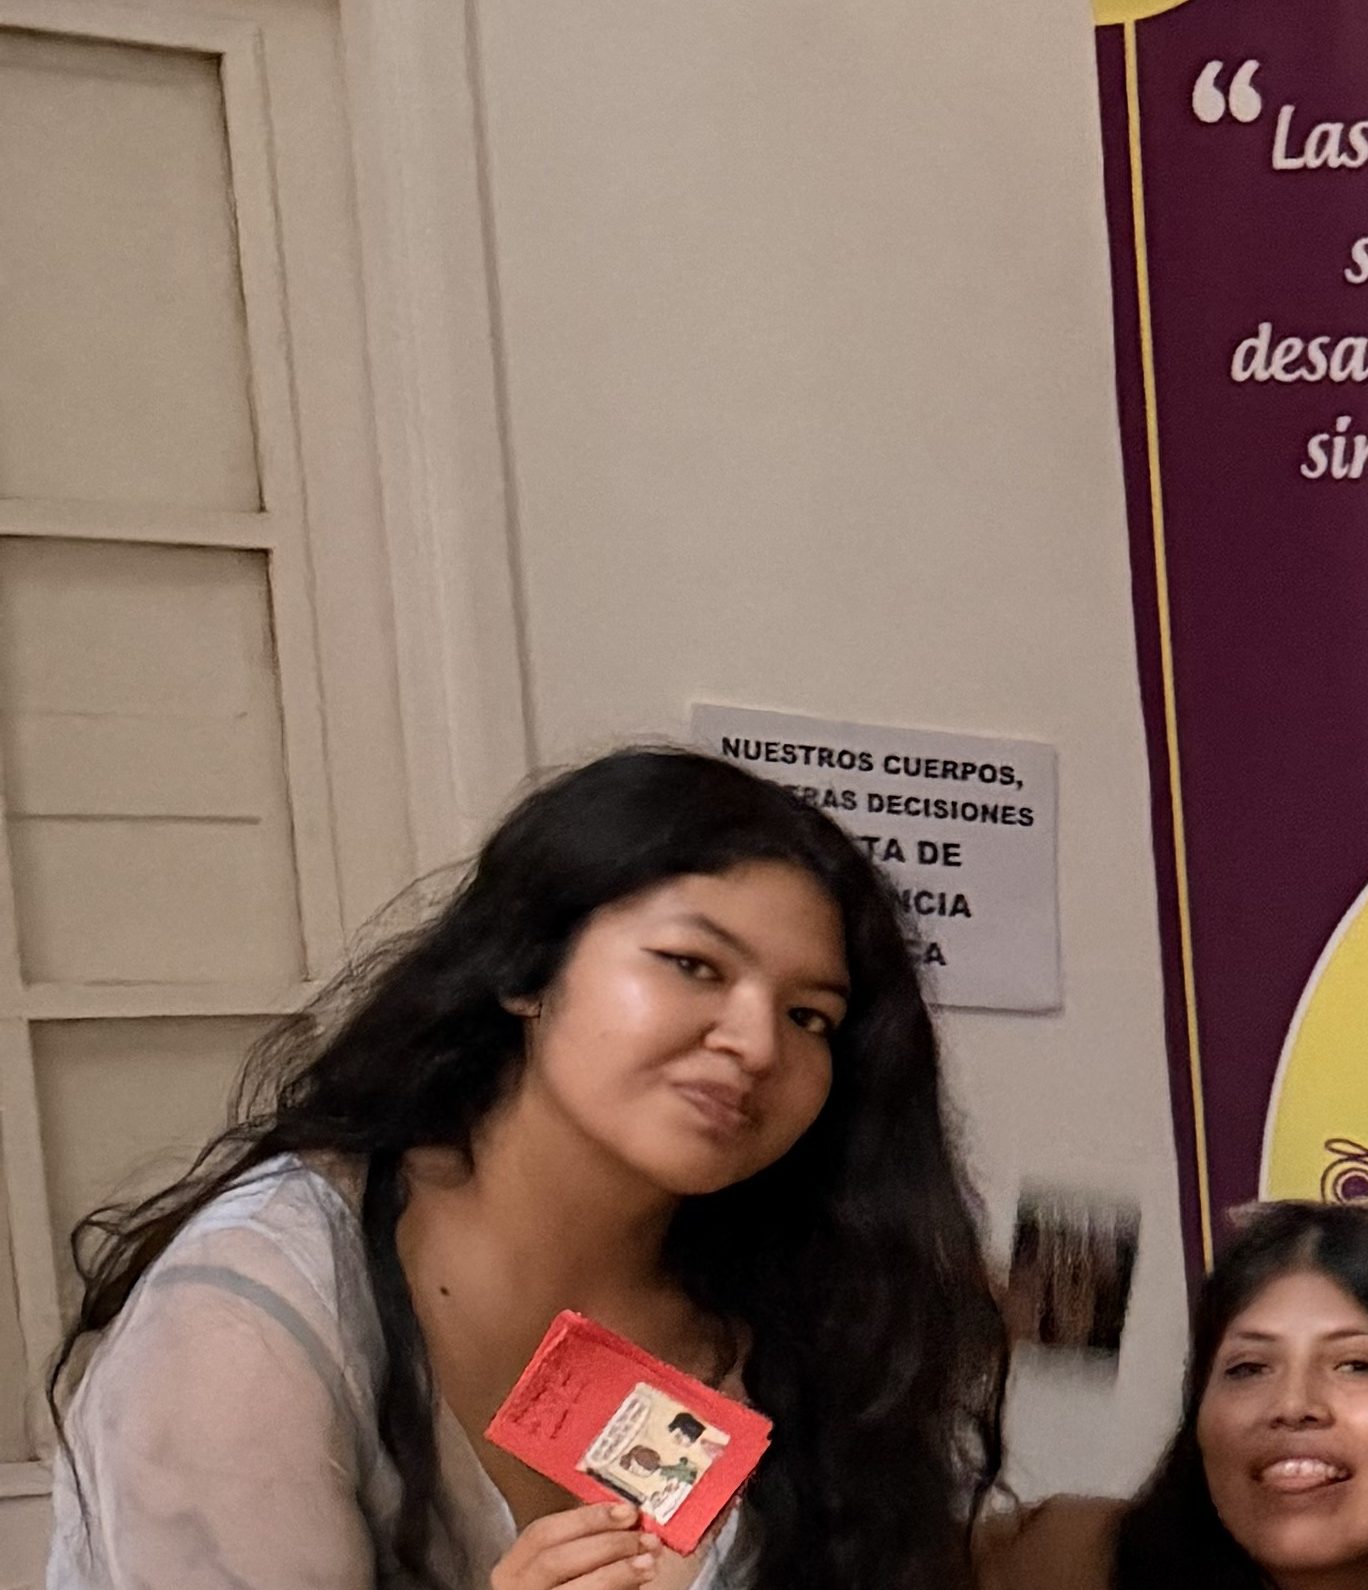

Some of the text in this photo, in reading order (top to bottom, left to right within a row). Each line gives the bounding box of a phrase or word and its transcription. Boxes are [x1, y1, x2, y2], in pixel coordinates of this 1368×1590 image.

[721, 736, 1024, 791] NUESTROS CUERPOS,
[867, 792, 1035, 827] DECISIONES
[917, 840, 963, 867] DE
